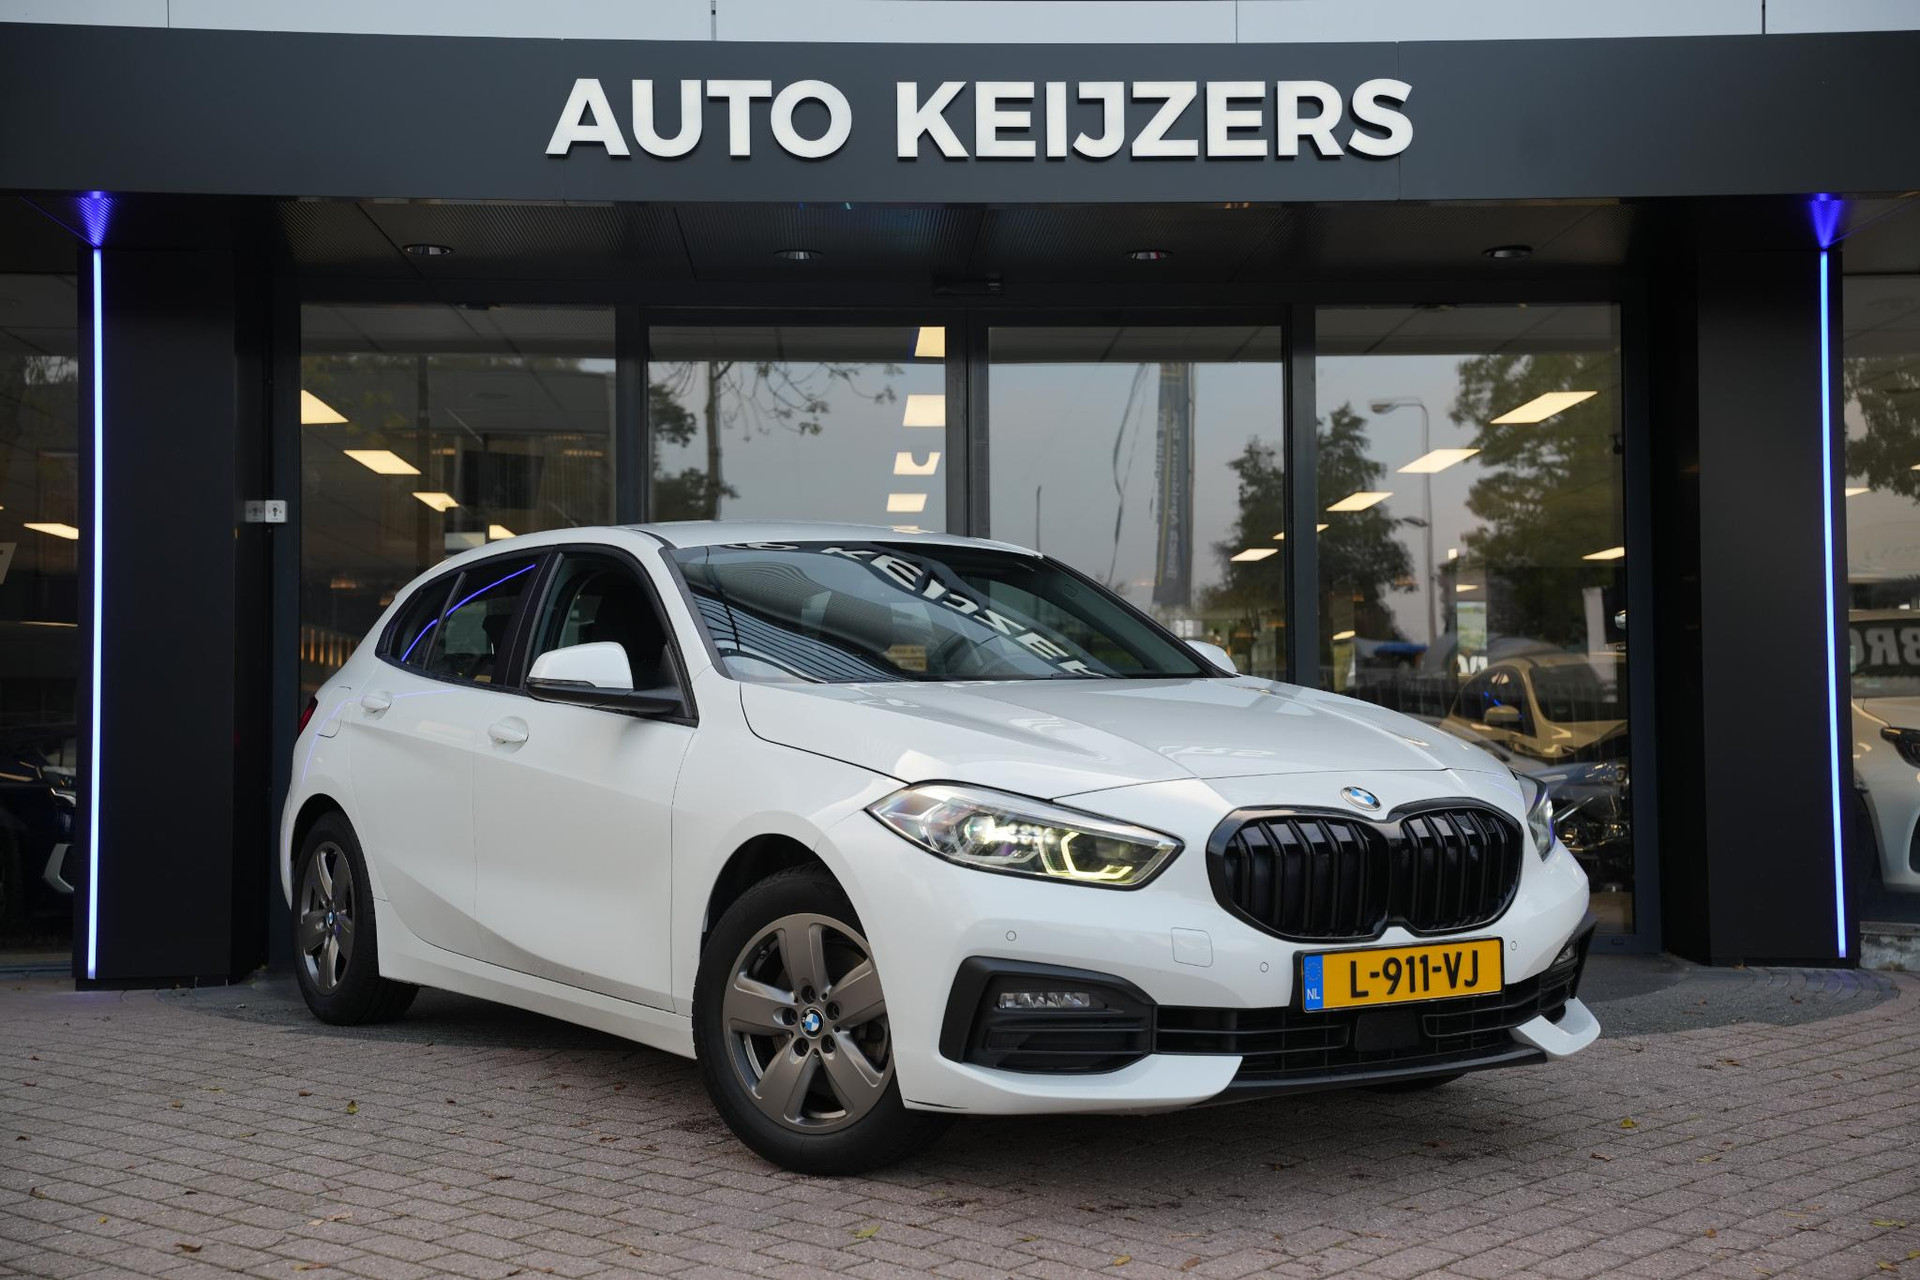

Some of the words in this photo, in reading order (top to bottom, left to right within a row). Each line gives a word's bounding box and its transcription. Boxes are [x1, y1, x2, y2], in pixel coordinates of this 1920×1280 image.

[546, 79, 852, 158] AUTO
[896, 79, 1414, 157] KEIJZERS
[1306, 988, 1321, 1000] NL
[1350, 949, 1479, 999] L-911-VJ
